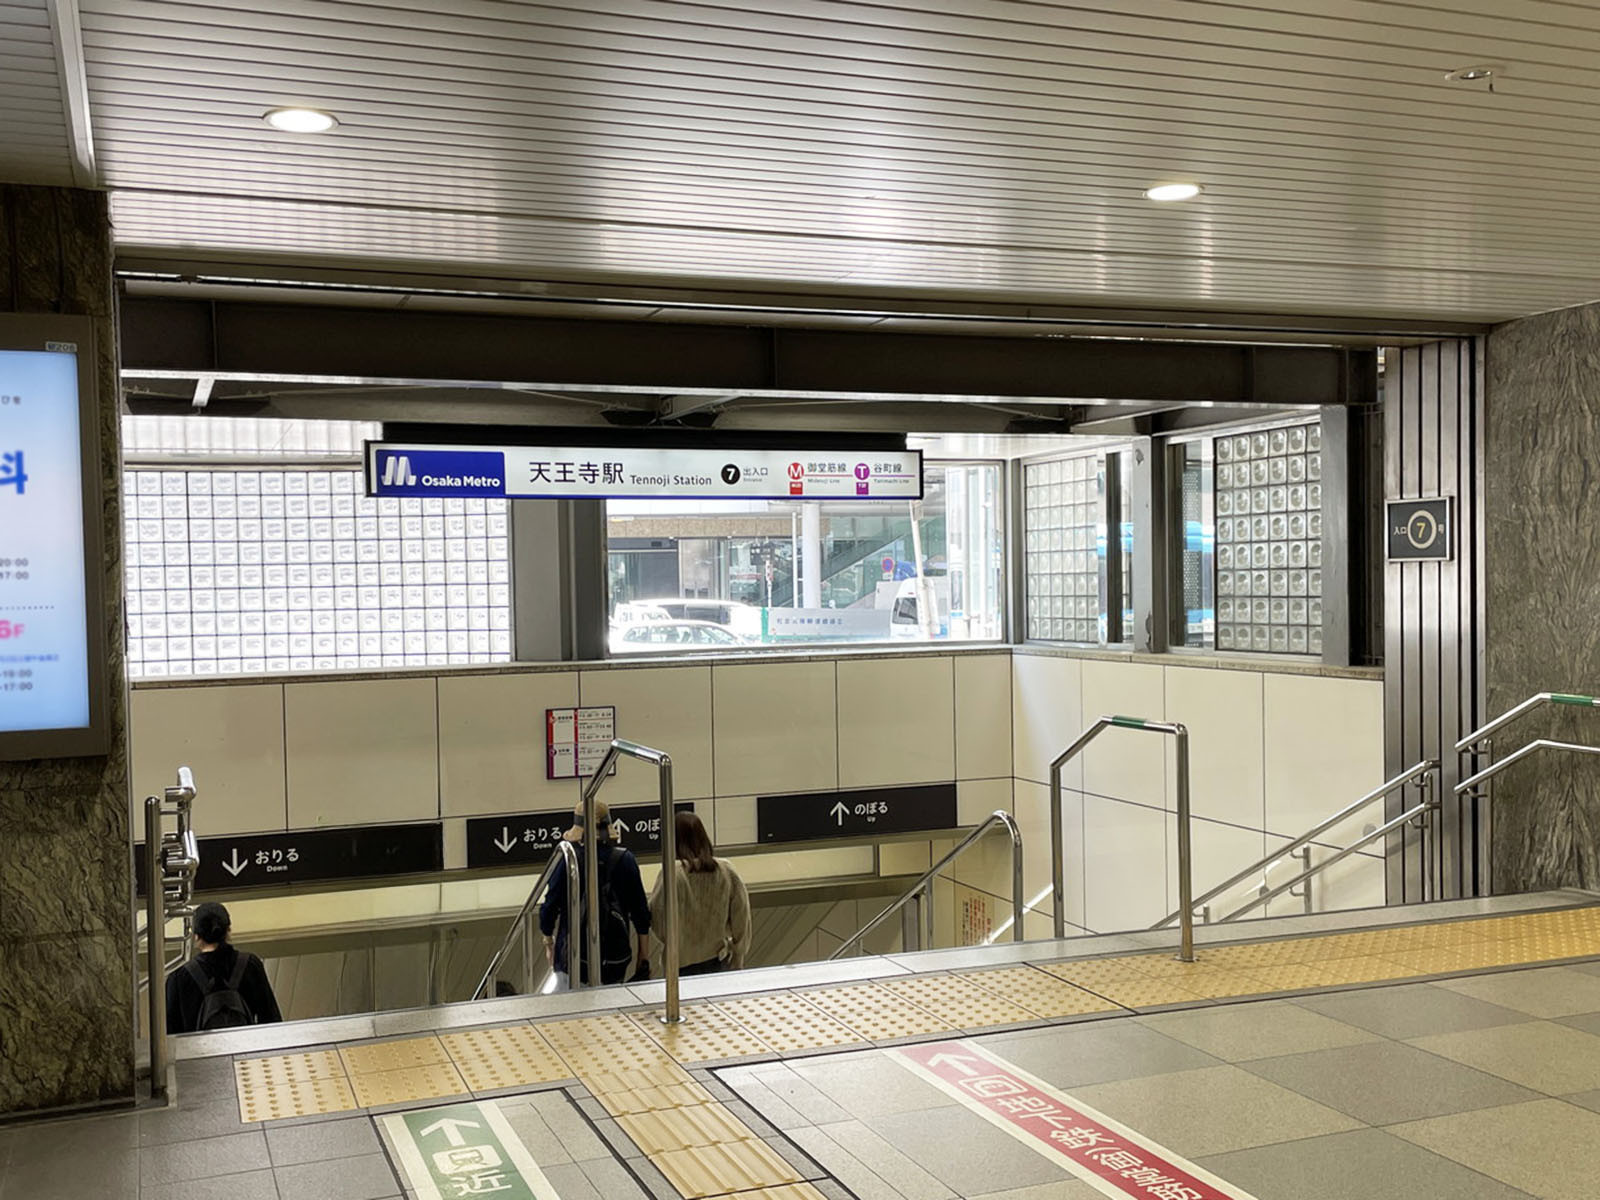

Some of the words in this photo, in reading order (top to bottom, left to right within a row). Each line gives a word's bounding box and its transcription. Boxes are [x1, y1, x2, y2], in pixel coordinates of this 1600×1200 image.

[529, 462, 625, 485] 天王寺駅
[726, 468, 736, 481] 7
[743, 467, 768, 476] 出入口
[789, 465, 802, 478] M
[857, 465, 867, 479] T
[874, 463, 902, 474] 谷町線
[421, 475, 462, 487] Osaka
[463, 475, 500, 487] Metro
[630, 475, 670, 487] Tennoji
[673, 475, 712, 486] Station
[1416, 522, 1426, 539] 7
[854, 801, 889, 815] のぼる
[635, 818, 661, 833] のぼ
[523, 826, 563, 842] おりる
[649, 833, 660, 841] Up
[533, 842, 553, 850] Down
[255, 848, 300, 865] おりる
[266, 864, 288, 873] Down
[450, 1169, 513, 1197] 近
